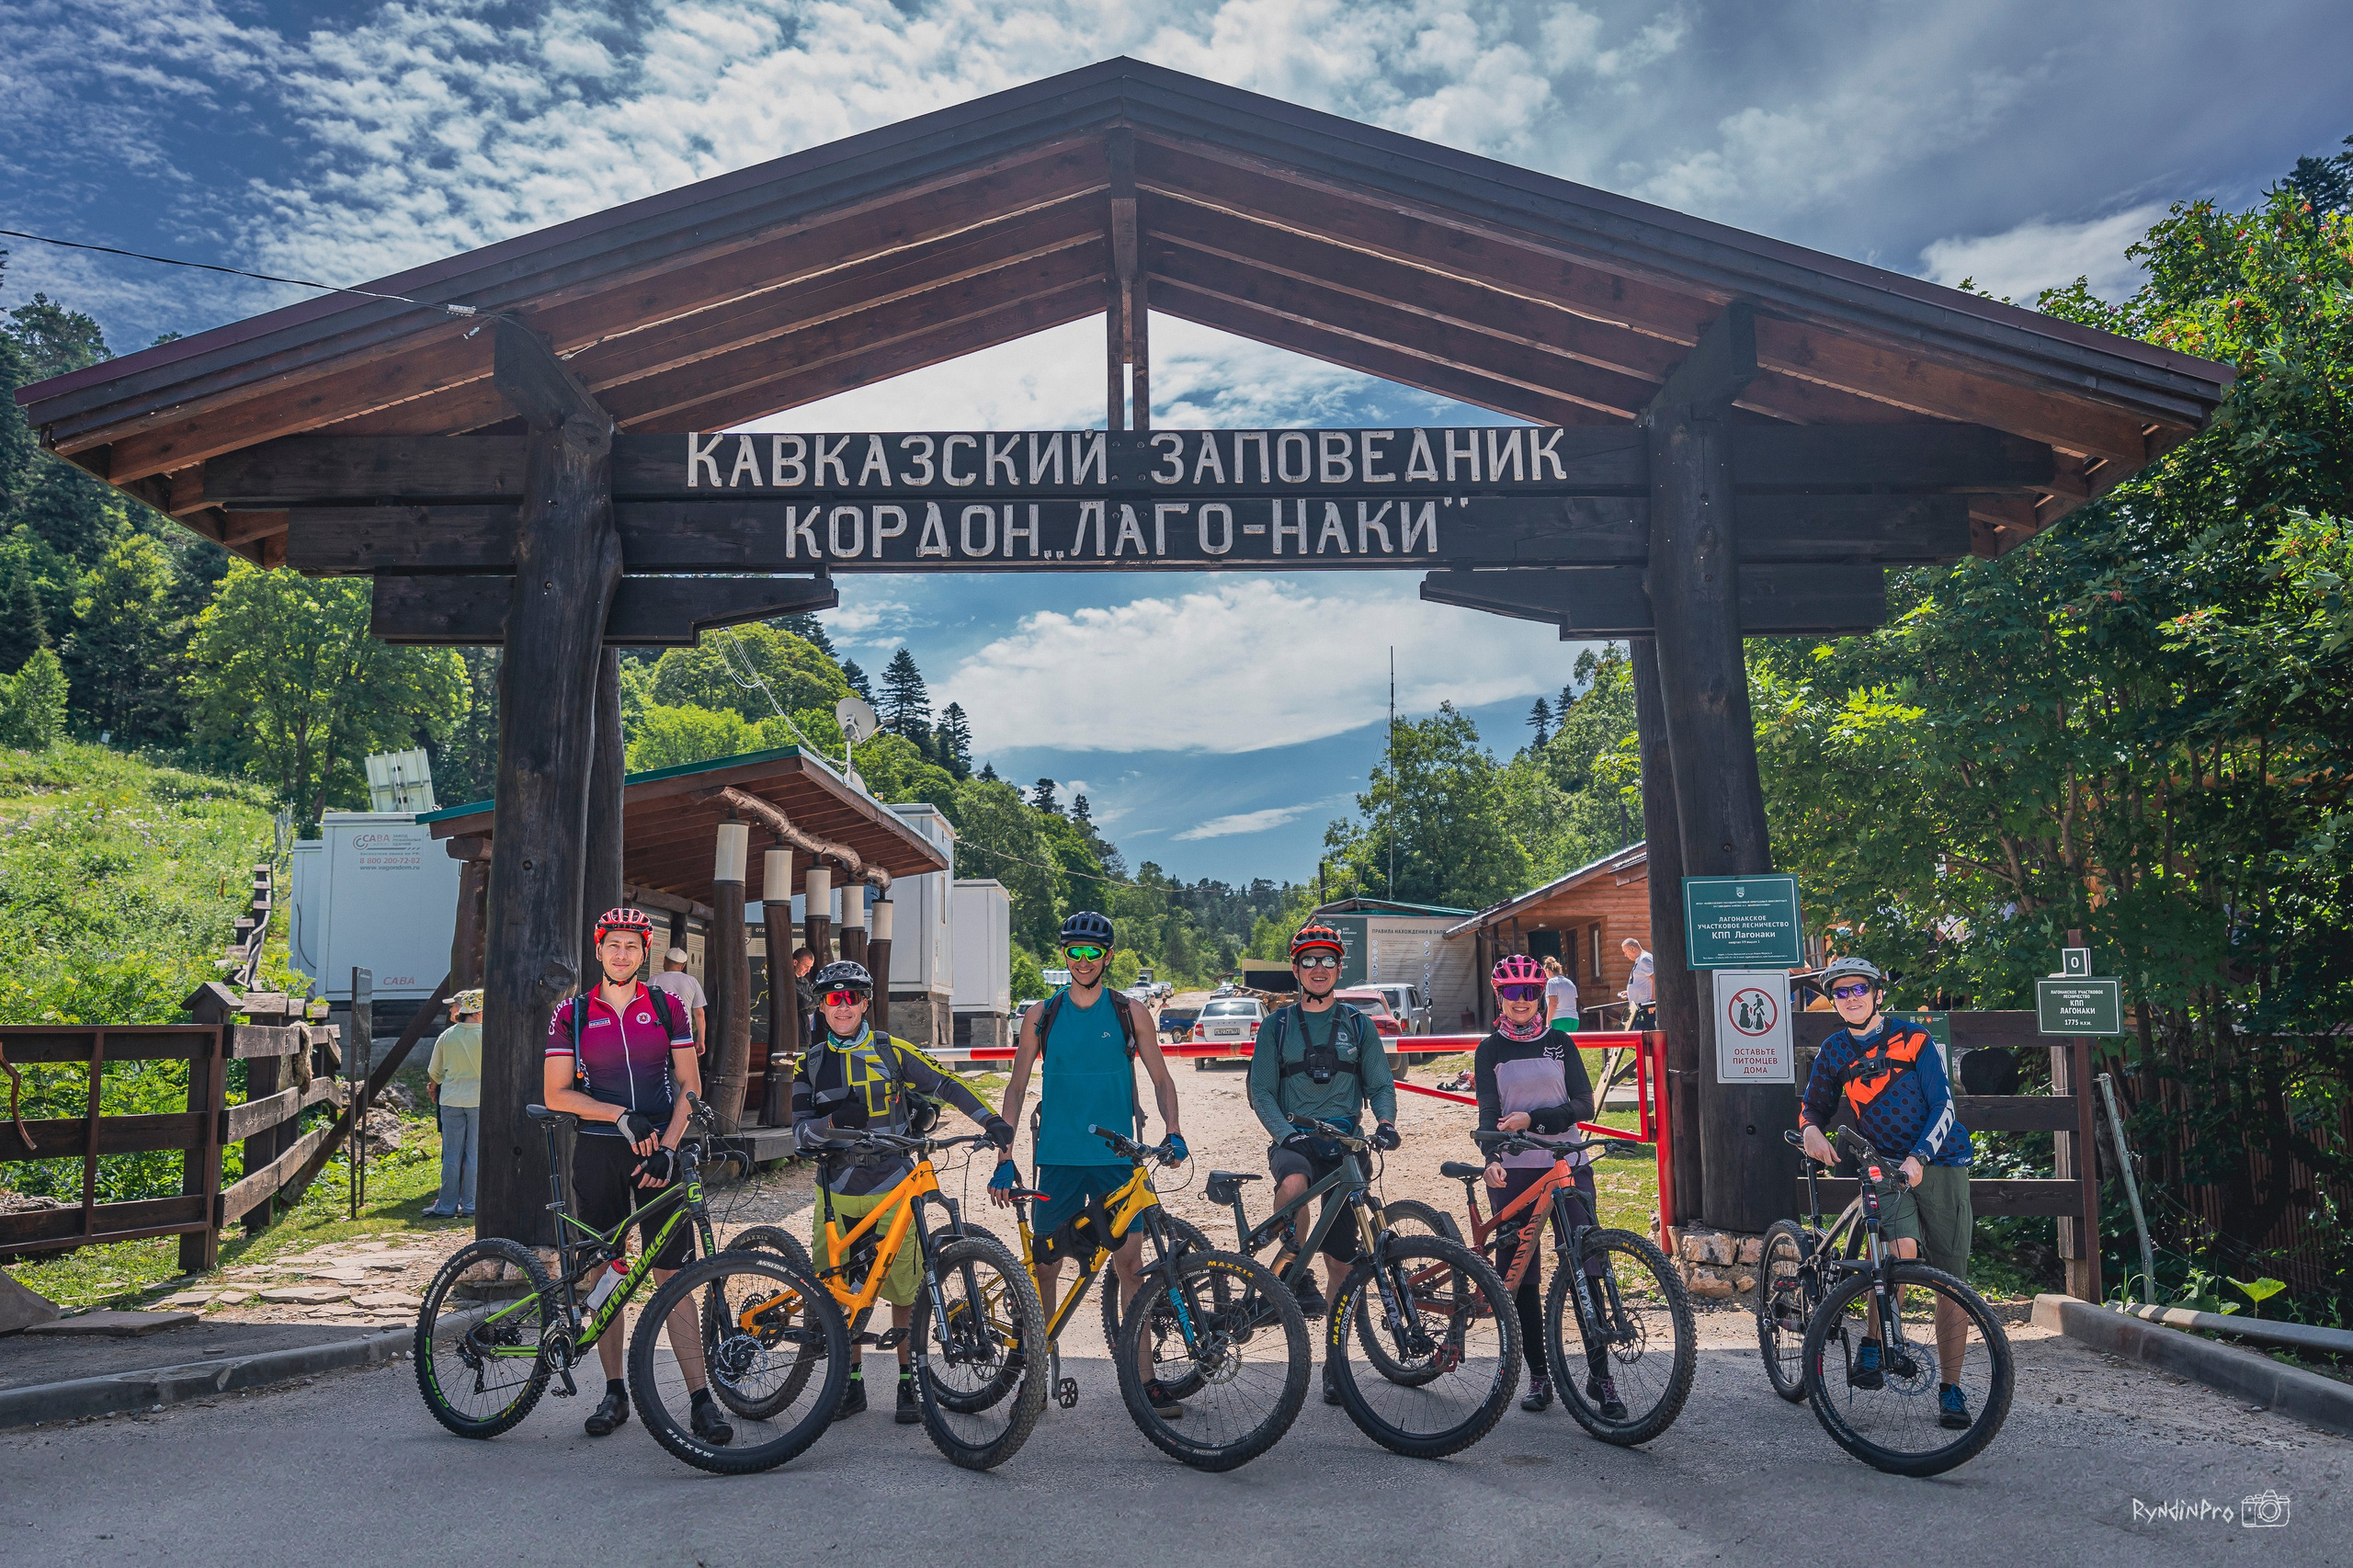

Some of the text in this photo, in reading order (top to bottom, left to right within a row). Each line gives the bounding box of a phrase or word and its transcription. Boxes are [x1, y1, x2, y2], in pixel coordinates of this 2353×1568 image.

[687, 426, 1567, 488] КАВКАЗСКИЙ ЗАПОВЕДНИК
[785, 501, 1040, 559] КОРДОН
[362, 834, 391, 842] САВА
[1719, 915, 1767, 923] ЛАГОНАКСКОЕ
[1742, 921, 1790, 929] ЛЕСНИЧЕСТВО
[1711, 930, 1776, 939] КПП Лагонаки
[382, 976, 415, 986] САВА
[1733, 1057, 1779, 1065] ПИТОМЦЕВ
[1743, 1066, 1768, 1074] ДОМА
[1207, 1260, 1254, 1278] MAXXIS
[1577, 1285, 1595, 1314] FOX
[1332, 1294, 1349, 1346] MAXXIS
[911, 1350, 925, 1403] MAXXIS
[665, 1427, 715, 1459] MAXXIS
